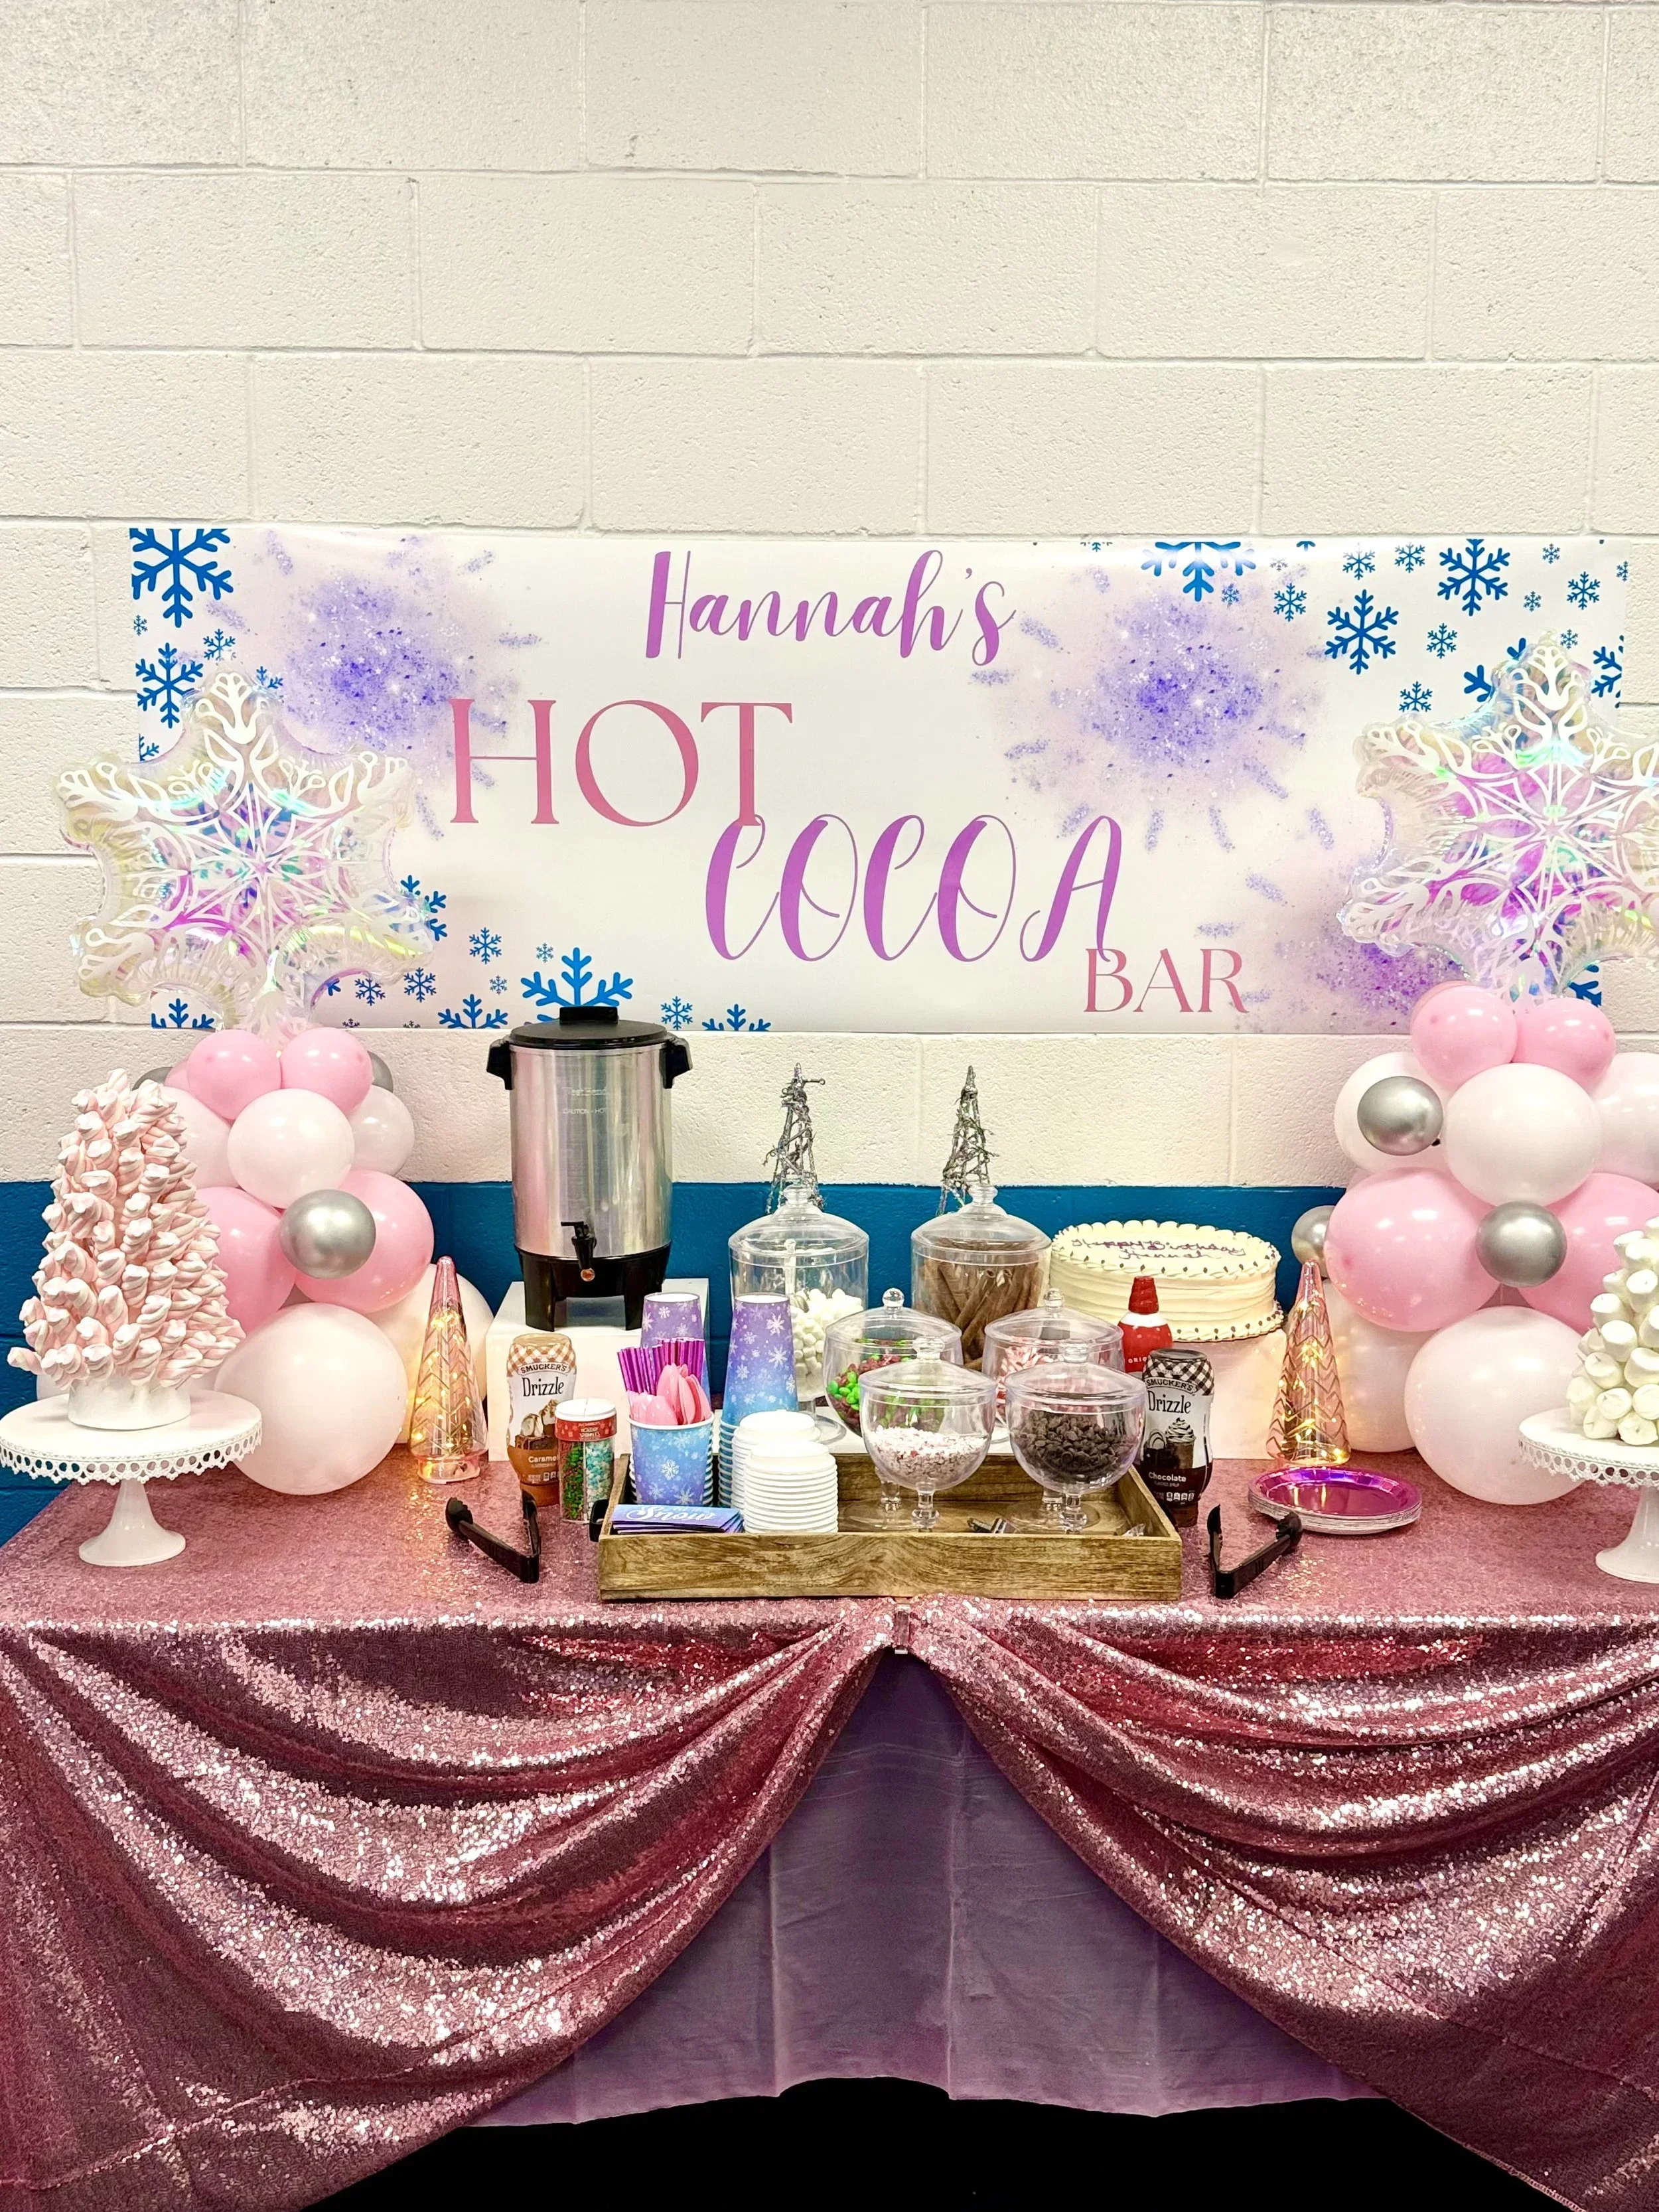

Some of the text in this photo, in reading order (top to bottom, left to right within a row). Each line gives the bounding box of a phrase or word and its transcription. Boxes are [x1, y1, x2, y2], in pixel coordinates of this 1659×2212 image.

[646, 550, 1015, 666] Hannah's
[450, 700, 793, 827] HOT
[705, 814, 1123, 963] COCOA
[1083, 948, 1248, 1014] BAR
[520, 1363, 567, 1374] SMUCKER'S
[522, 1376, 565, 1397] Drizzle
[1146, 1378, 1194, 1392] SMUCKER'S
[1147, 1390, 1192, 1414] Drizzle
[1148, 1471, 1187, 1483] Chocolate
[626, 1505, 717, 1521] Snow
